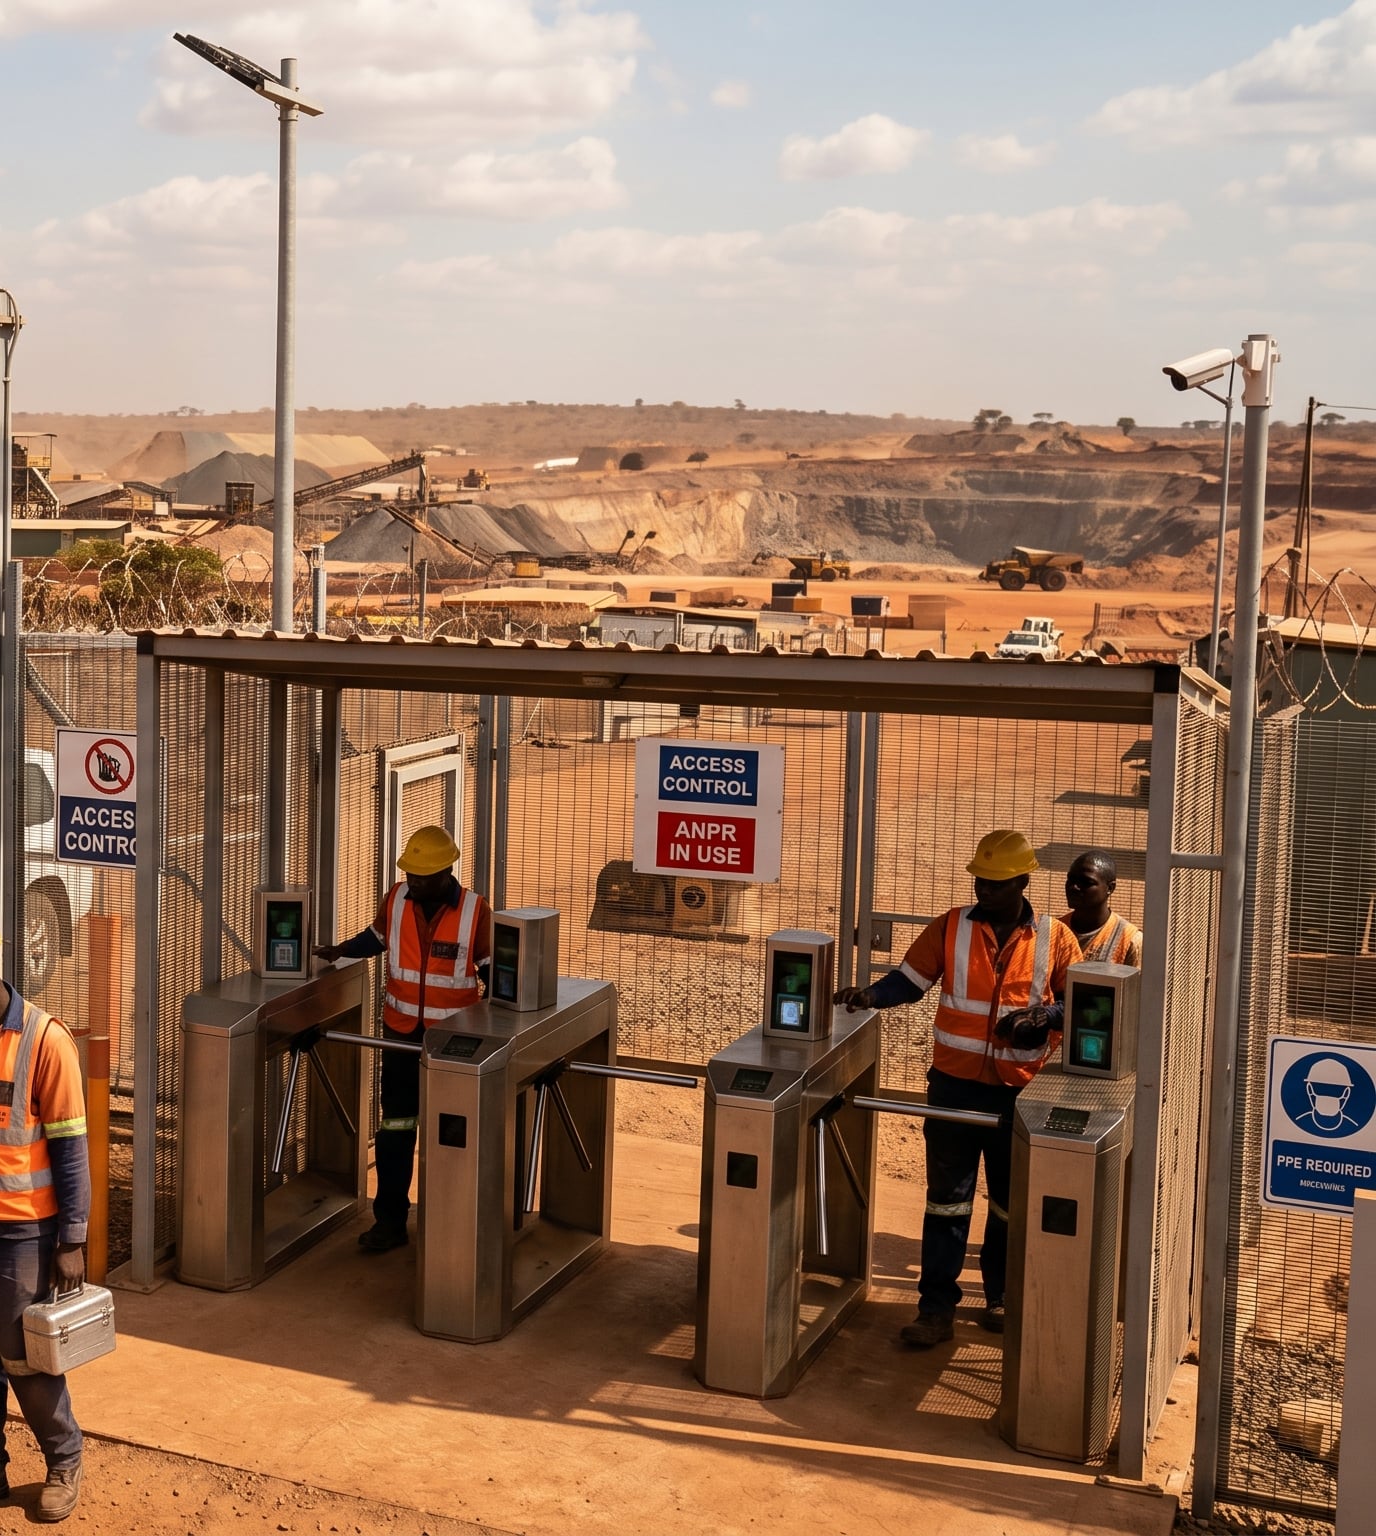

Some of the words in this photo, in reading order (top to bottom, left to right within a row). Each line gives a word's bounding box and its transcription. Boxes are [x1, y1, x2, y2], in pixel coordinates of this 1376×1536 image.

[669, 755, 746, 774] ACCESS
[662, 776, 753, 797] CONTROL
[70, 806, 135, 830] ACCES
[675, 821, 737, 842] ANPR
[669, 843, 690, 862] IN
[697, 845, 741, 865] USE
[1276, 1154, 1302, 1170] PPE
[1305, 1158, 1372, 1179] REQUIRED
